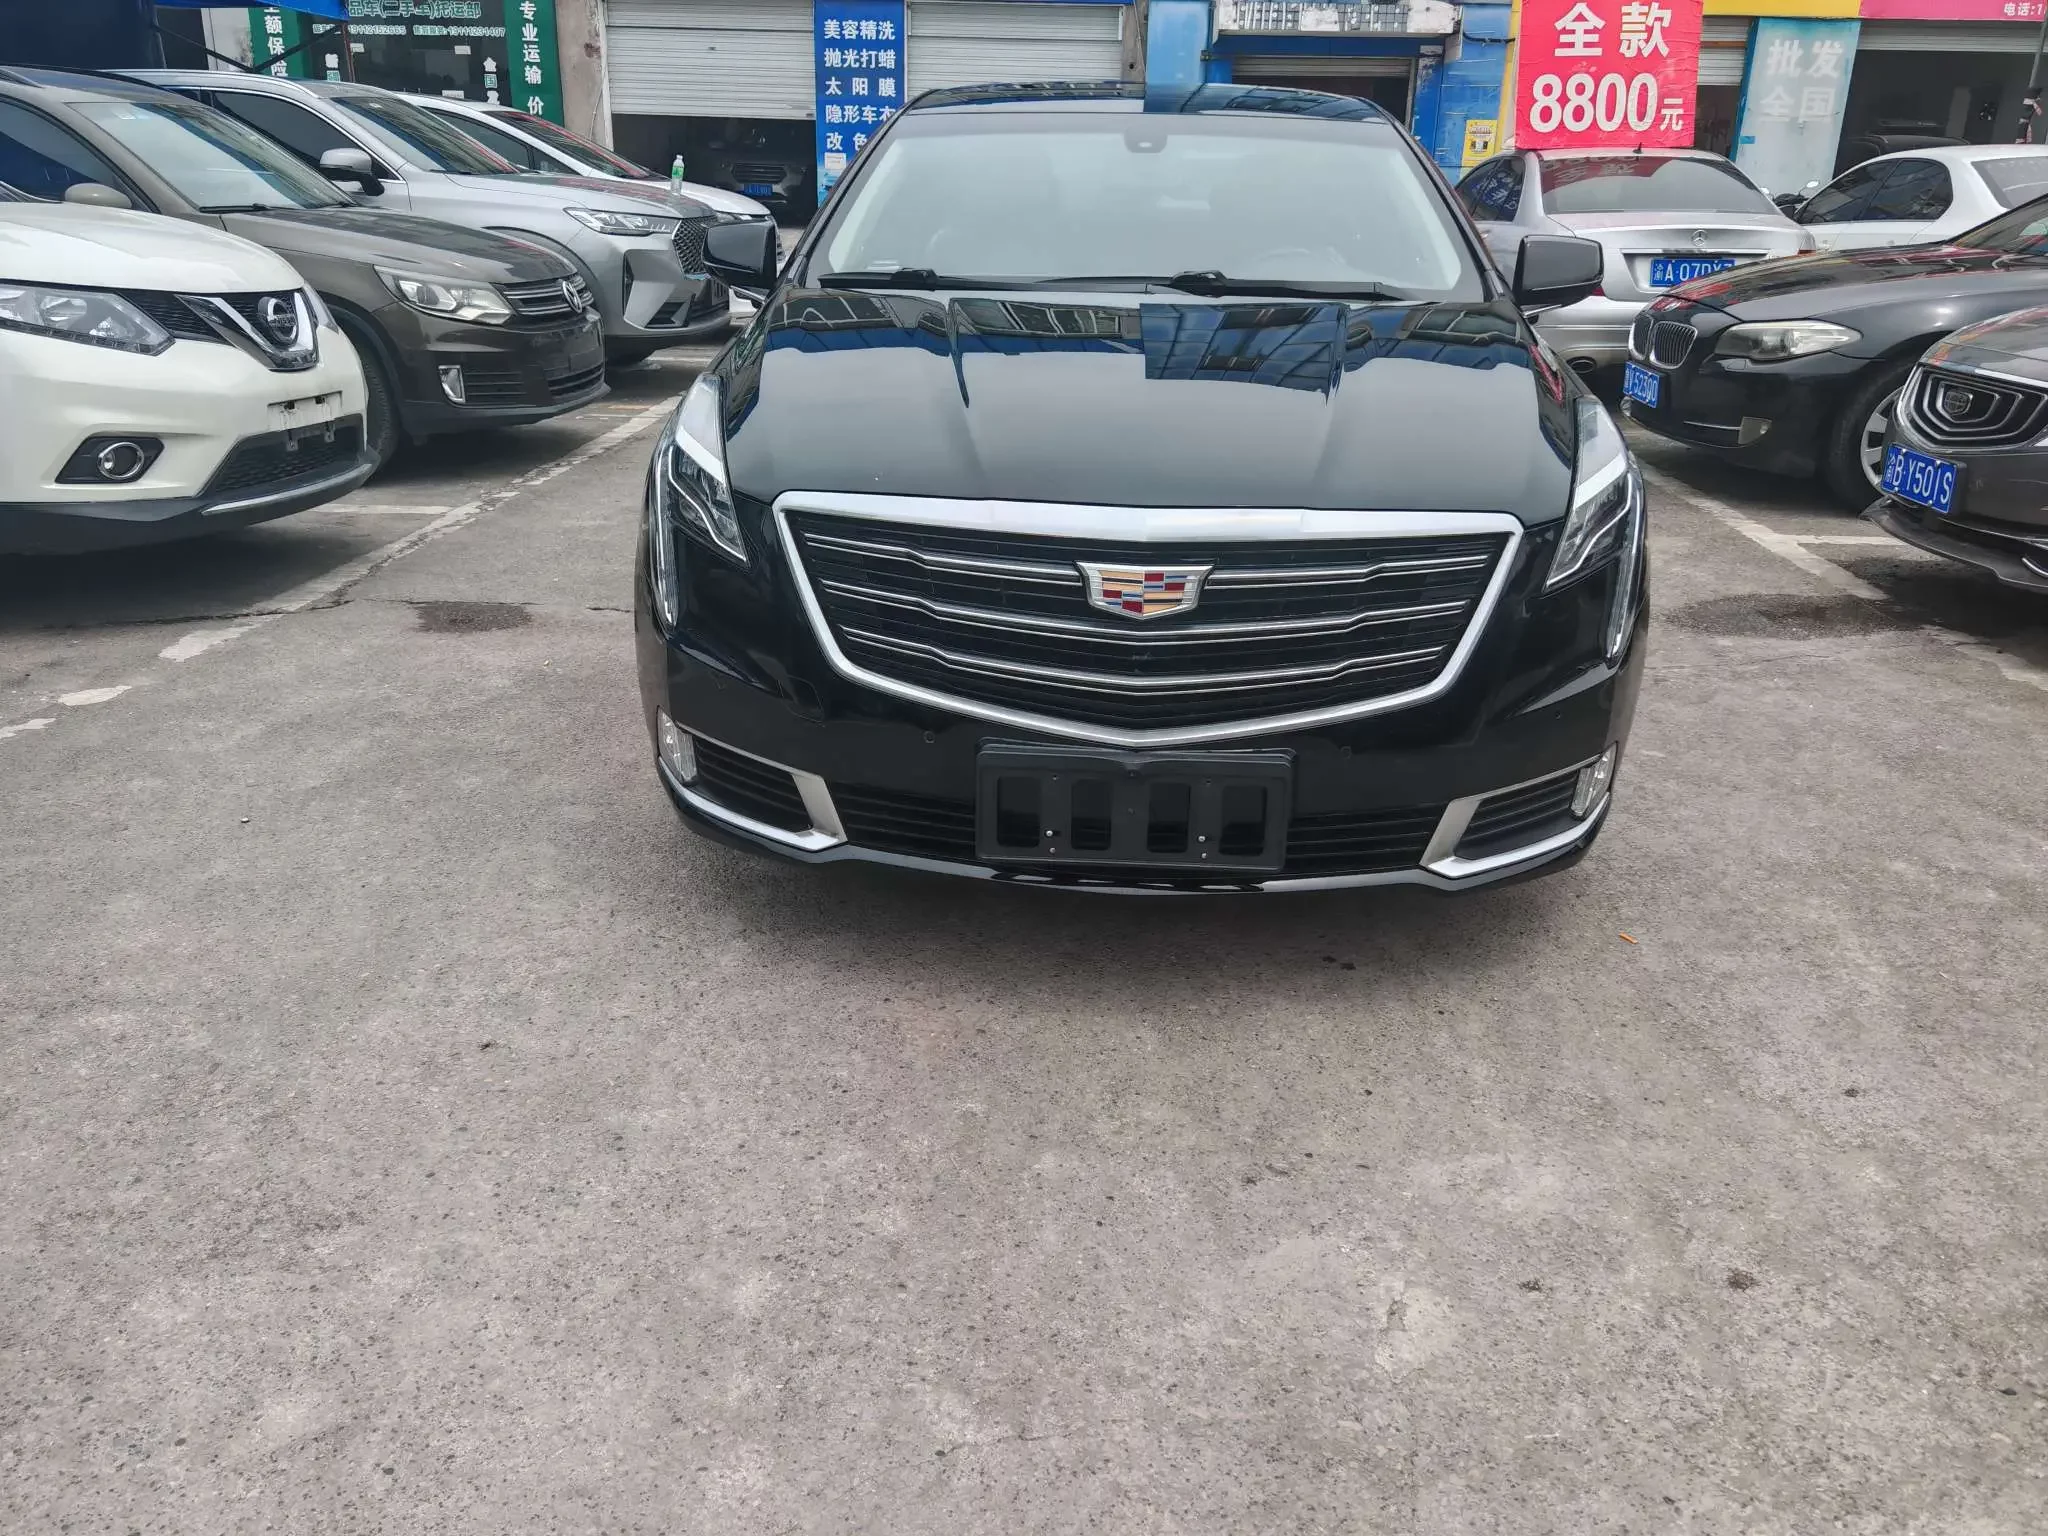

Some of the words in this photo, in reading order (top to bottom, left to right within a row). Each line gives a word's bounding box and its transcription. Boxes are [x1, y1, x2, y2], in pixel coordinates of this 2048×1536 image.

[2004, 2, 2046, 16] 电话:1
[823, 19, 896, 41] 美容精洗
[1553, 2, 1673, 58] 全款
[519, 1, 542, 84] 专业运输
[824, 48, 896, 69] 抛光打蜡
[1767, 39, 1844, 79] 批发
[825, 77, 897, 97] 太阳膜
[527, 96, 544, 115] 价
[825, 105, 896, 124] 隐形车衣
[1756, 86, 1836, 124] 全国
